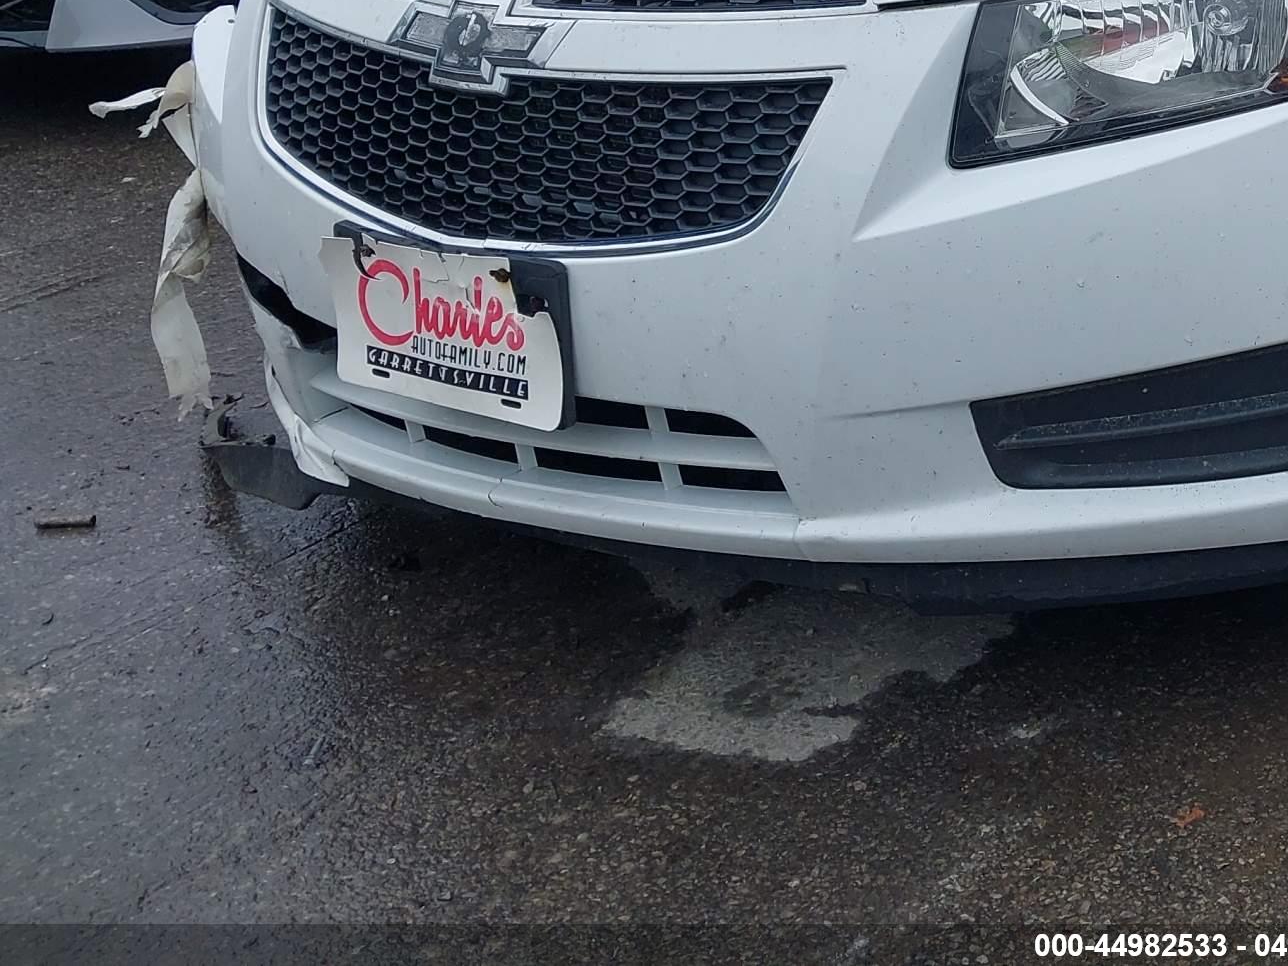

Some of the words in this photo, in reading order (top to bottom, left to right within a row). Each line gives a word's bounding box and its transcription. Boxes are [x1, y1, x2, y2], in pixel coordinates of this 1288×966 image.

[358, 259, 525, 351] Charles
[368, 347, 527, 398] GARRETTSVILLE
[412, 338, 527, 375] AUTOFAMILY.COM
